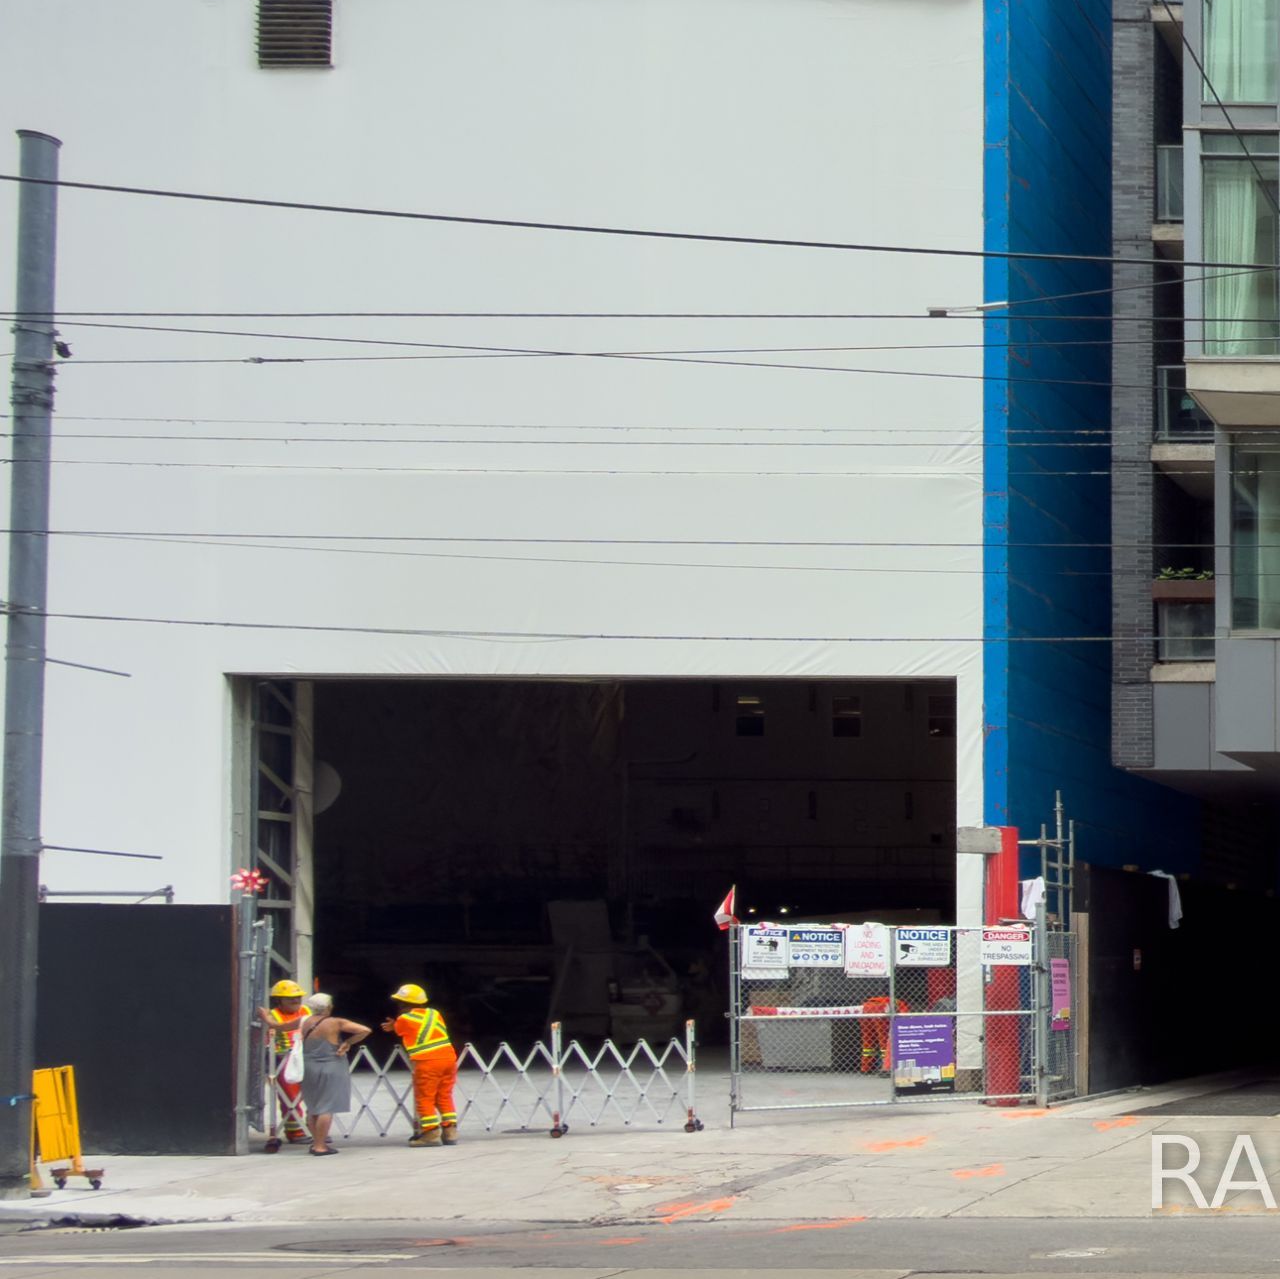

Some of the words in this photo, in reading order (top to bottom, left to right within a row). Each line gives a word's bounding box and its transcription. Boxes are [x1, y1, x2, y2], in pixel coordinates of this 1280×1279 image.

[801, 932, 841, 941] NOTICE
[863, 930, 873, 938] NO
[900, 930, 947, 940] NOTICE
[987, 932, 1024, 940] DANGER
[854, 941, 882, 949] LOADING
[848, 961, 885, 969] UNLOADING
